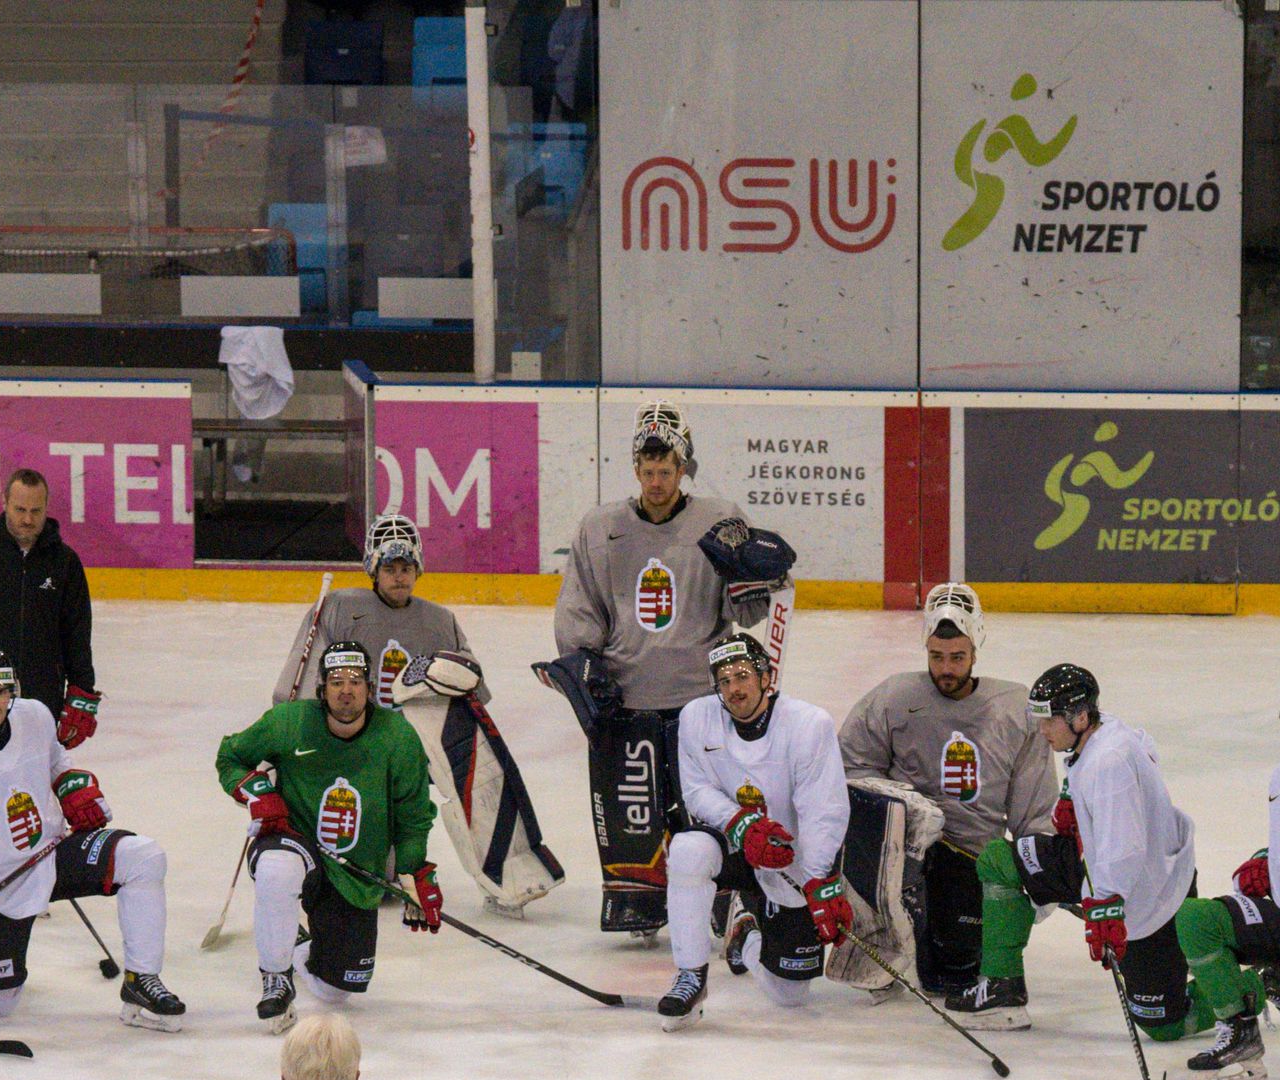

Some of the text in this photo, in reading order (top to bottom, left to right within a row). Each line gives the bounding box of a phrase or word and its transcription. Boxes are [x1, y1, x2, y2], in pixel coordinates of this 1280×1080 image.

[1042, 172, 1221, 213] SPORTOLÓ
[1013, 224, 1147, 253] NEMZET
[748, 439, 829, 453] MAGYAR
[748, 464, 866, 480] JÉGKORONG
[748, 490, 866, 506] SZÖVETSÉG
[1122, 491, 1280, 523] SPORTOLÓ
[1097, 528, 1216, 552] NEMZET
[617, 739, 658, 834] tellus
